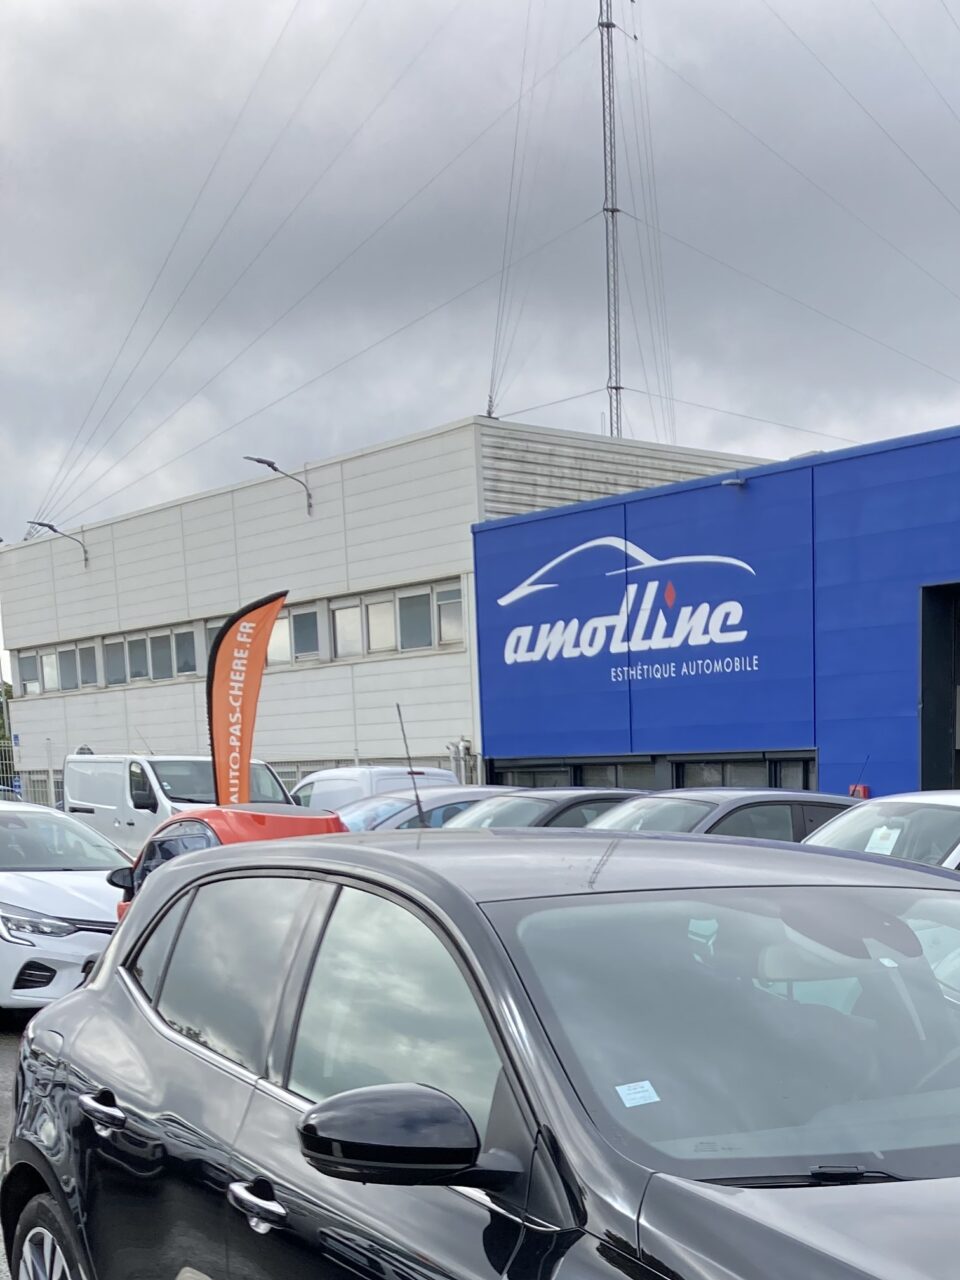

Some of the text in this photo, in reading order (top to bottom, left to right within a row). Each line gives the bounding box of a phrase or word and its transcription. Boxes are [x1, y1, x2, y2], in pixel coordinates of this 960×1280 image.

[228, 621, 256, 804] AUTO-PAS-CHERE.FR
[610, 656, 759, 681] ESTHÉTIQUE AUTOMOBILE
